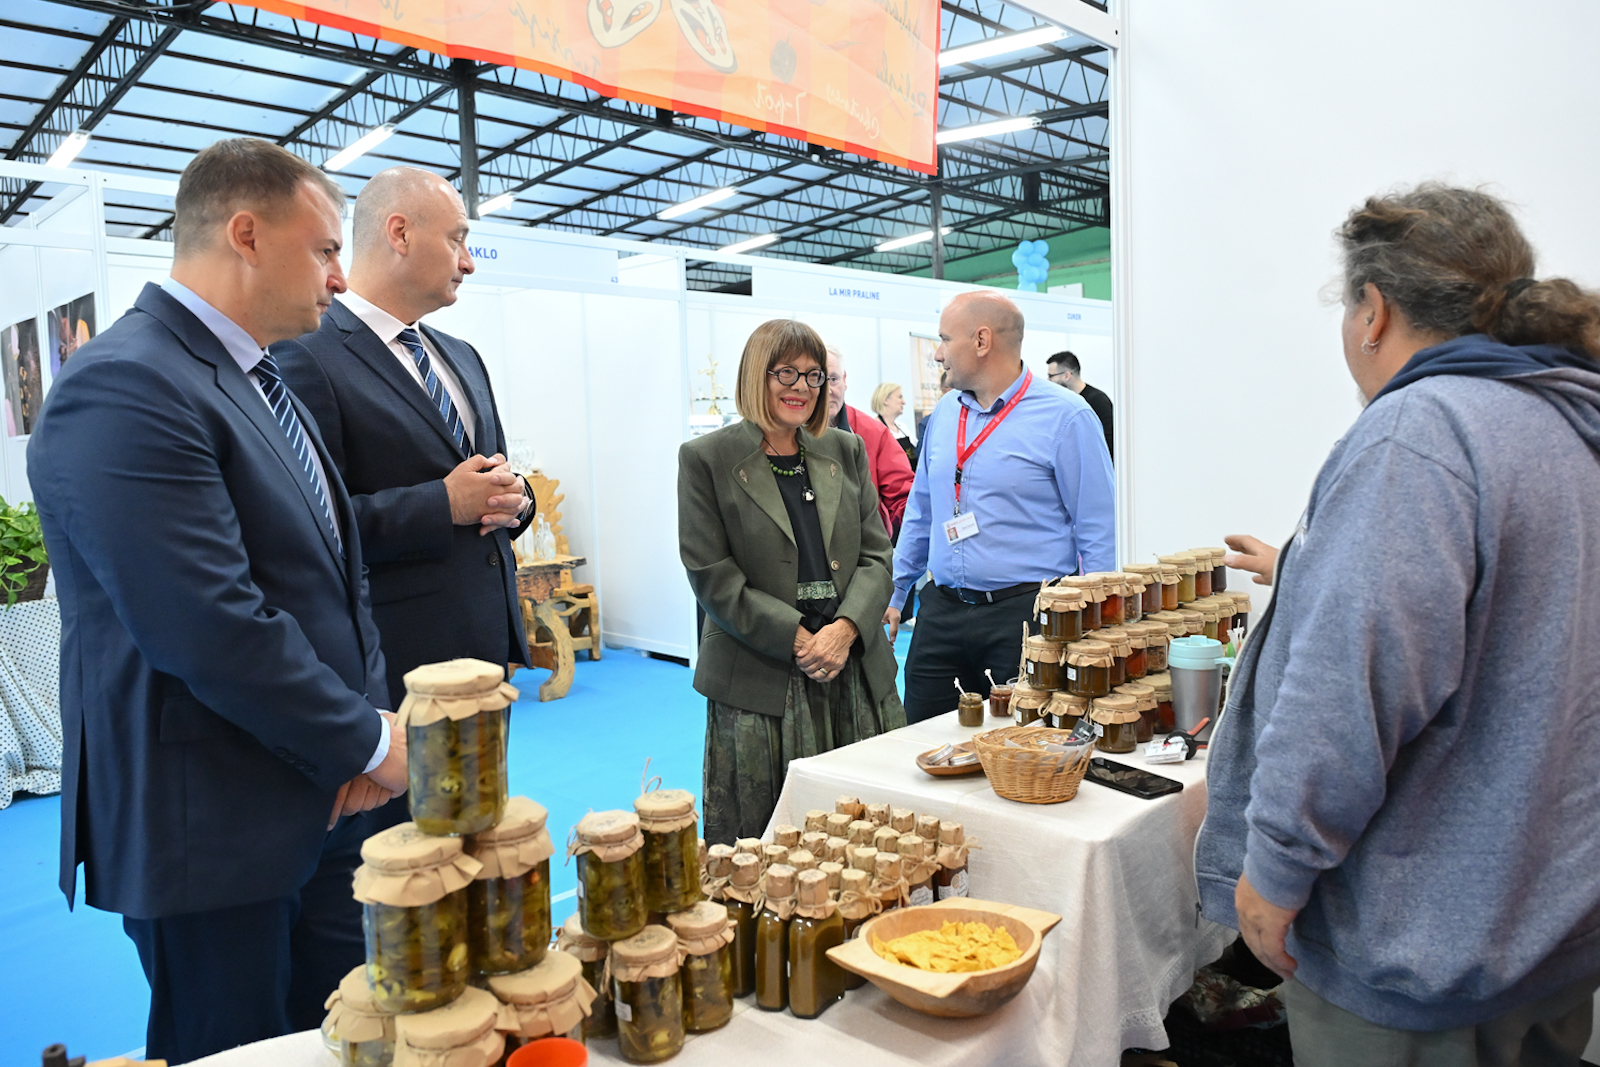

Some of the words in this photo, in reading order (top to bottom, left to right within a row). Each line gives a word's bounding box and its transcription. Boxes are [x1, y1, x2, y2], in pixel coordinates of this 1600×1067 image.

[829, 287, 838, 296] LA
[839, 288, 851, 298] MIR
[853, 289, 880, 300] PRALINE
